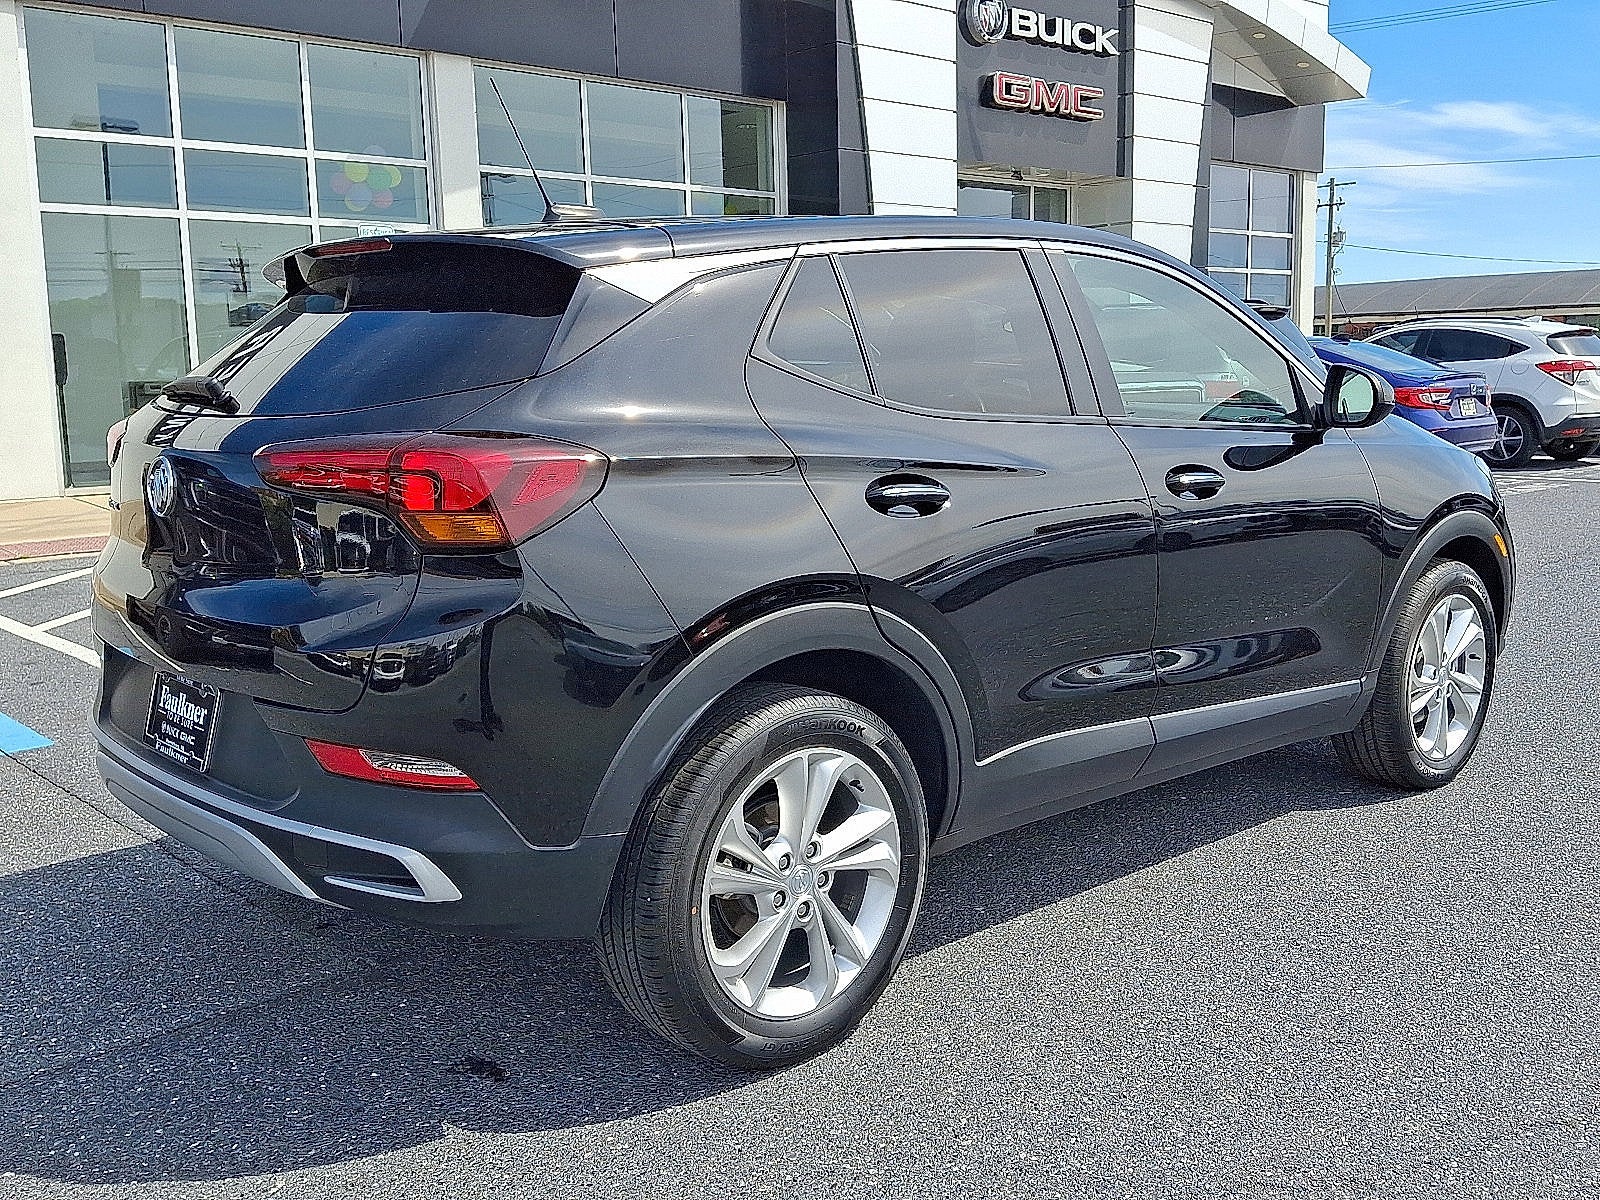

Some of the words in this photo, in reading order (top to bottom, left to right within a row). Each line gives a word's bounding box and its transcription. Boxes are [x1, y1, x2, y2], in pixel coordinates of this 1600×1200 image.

[1011, 7, 1120, 56] BUICK
[994, 70, 1104, 120] GMC
[158, 684, 208, 726] Faulkner
[155, 740, 189, 764] Faulkner
